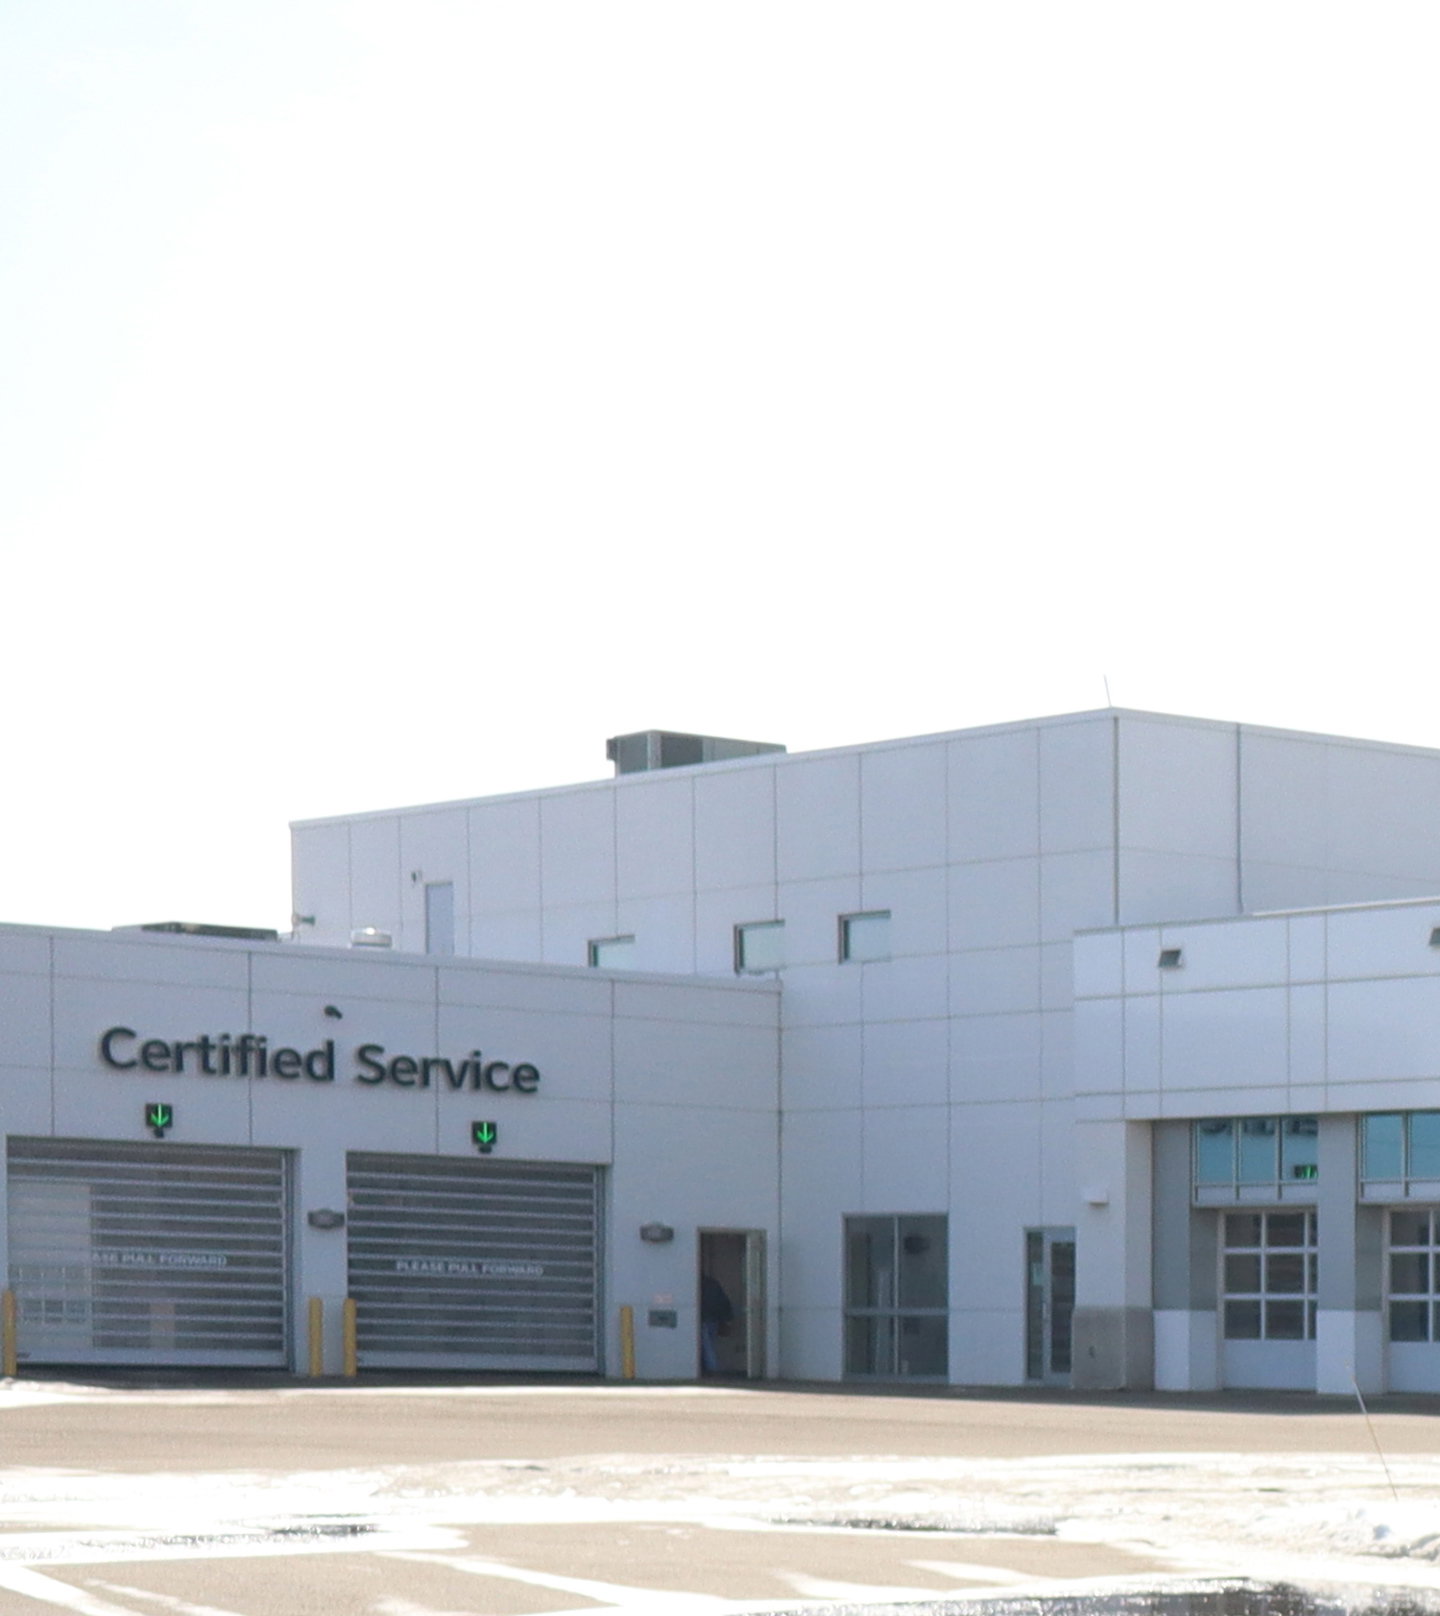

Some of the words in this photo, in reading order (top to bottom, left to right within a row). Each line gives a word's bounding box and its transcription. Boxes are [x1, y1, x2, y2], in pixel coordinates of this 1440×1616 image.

[99, 1026, 336, 1084] Certified
[355, 1043, 541, 1094] Service
[396, 1260, 443, 1274] PLEASE
